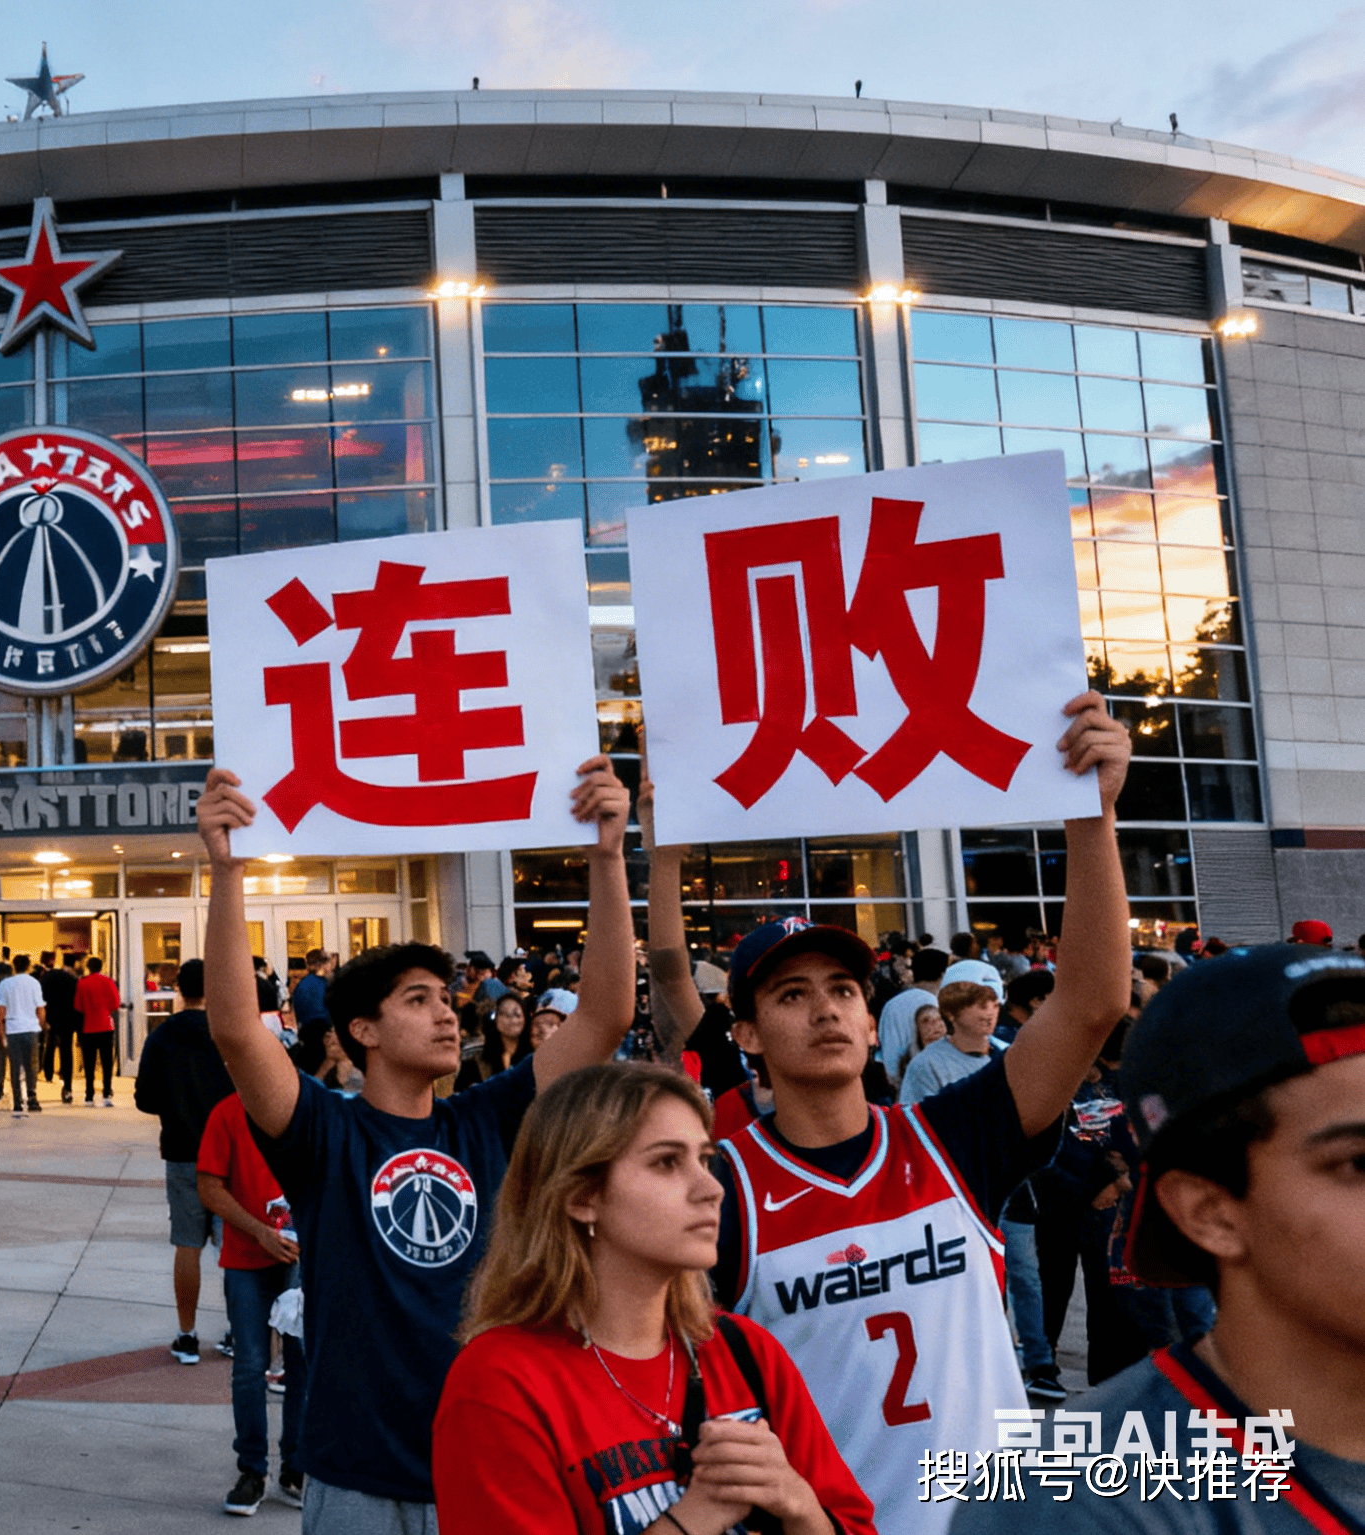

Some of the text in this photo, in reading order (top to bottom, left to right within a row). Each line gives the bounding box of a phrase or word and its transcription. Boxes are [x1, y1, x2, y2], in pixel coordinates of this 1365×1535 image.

[262, 560, 538, 834] 连
[703, 498, 1031, 809] 败
[864, 1310, 932, 1427] 2
